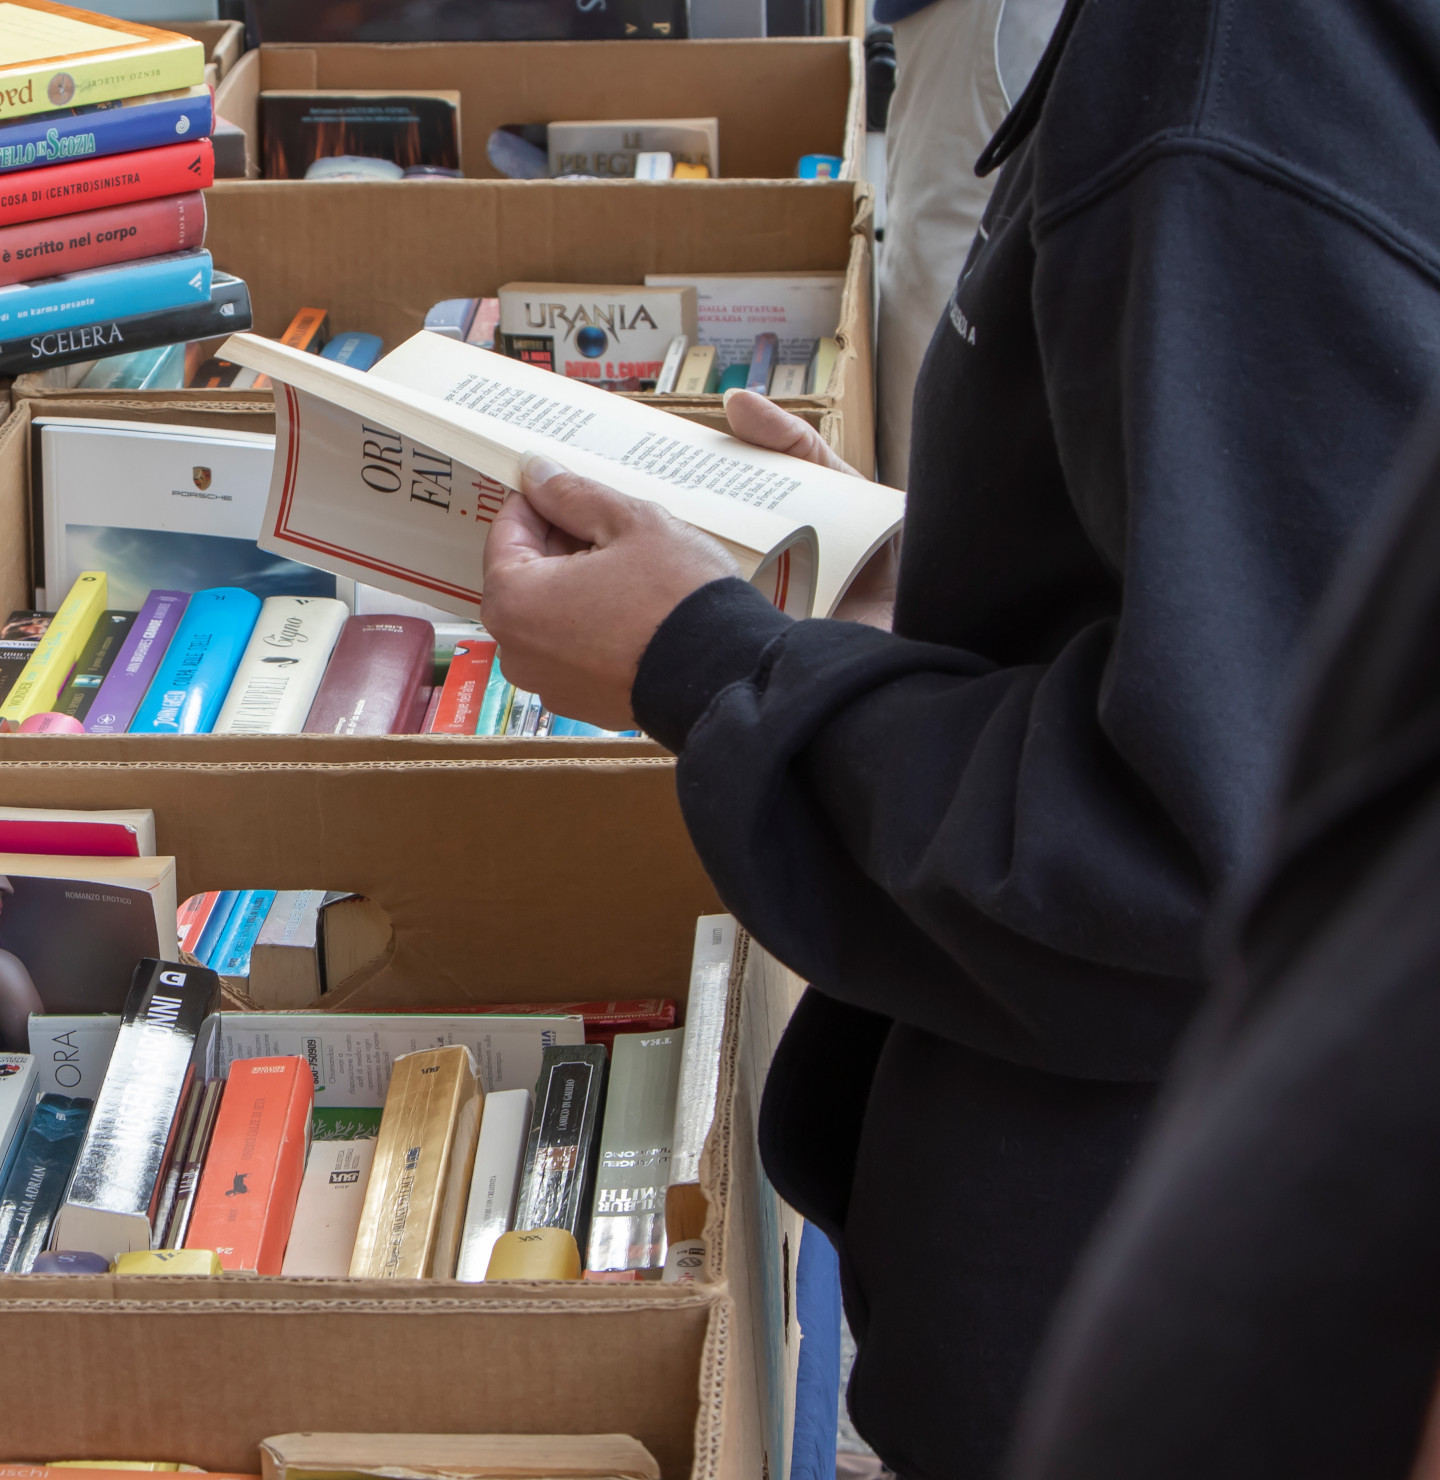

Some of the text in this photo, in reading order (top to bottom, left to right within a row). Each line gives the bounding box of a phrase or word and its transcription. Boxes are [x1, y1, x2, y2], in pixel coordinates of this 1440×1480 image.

[88, 69, 161, 88] RENZO ALLEGRI
[1, 192, 28, 207] COSA
[31, 189, 42, 202] DI
[45, 172, 140, 201] (CENTRO)SINISTRA
[2, 248, 11, 263] è
[16, 238, 64, 260] scritto
[68, 232, 91, 249] nel
[96, 225, 138, 246] corpo
[17, 309, 28, 318] un
[30, 303, 58, 316] karma
[60, 297, 95, 313] pesante
[524, 301, 658, 343] URANIA
[30, 323, 124, 358] SCELERA
[171, 490, 232, 501] PORSCHE
[263, 616, 308, 648] Cigno
[9, 681, 32, 708] WONDER
[65, 891, 132, 905] ROMANZO EROTICO
[55, 1030, 82, 1088] ORA
[640, 1039, 672, 1047] TEA
[558, 1109, 571, 1132] L'AMICO
[565, 1078, 576, 1103] GALILEO
[15, 1164, 48, 1222] LARA ADRIAN
[330, 1171, 359, 1183] BUR
